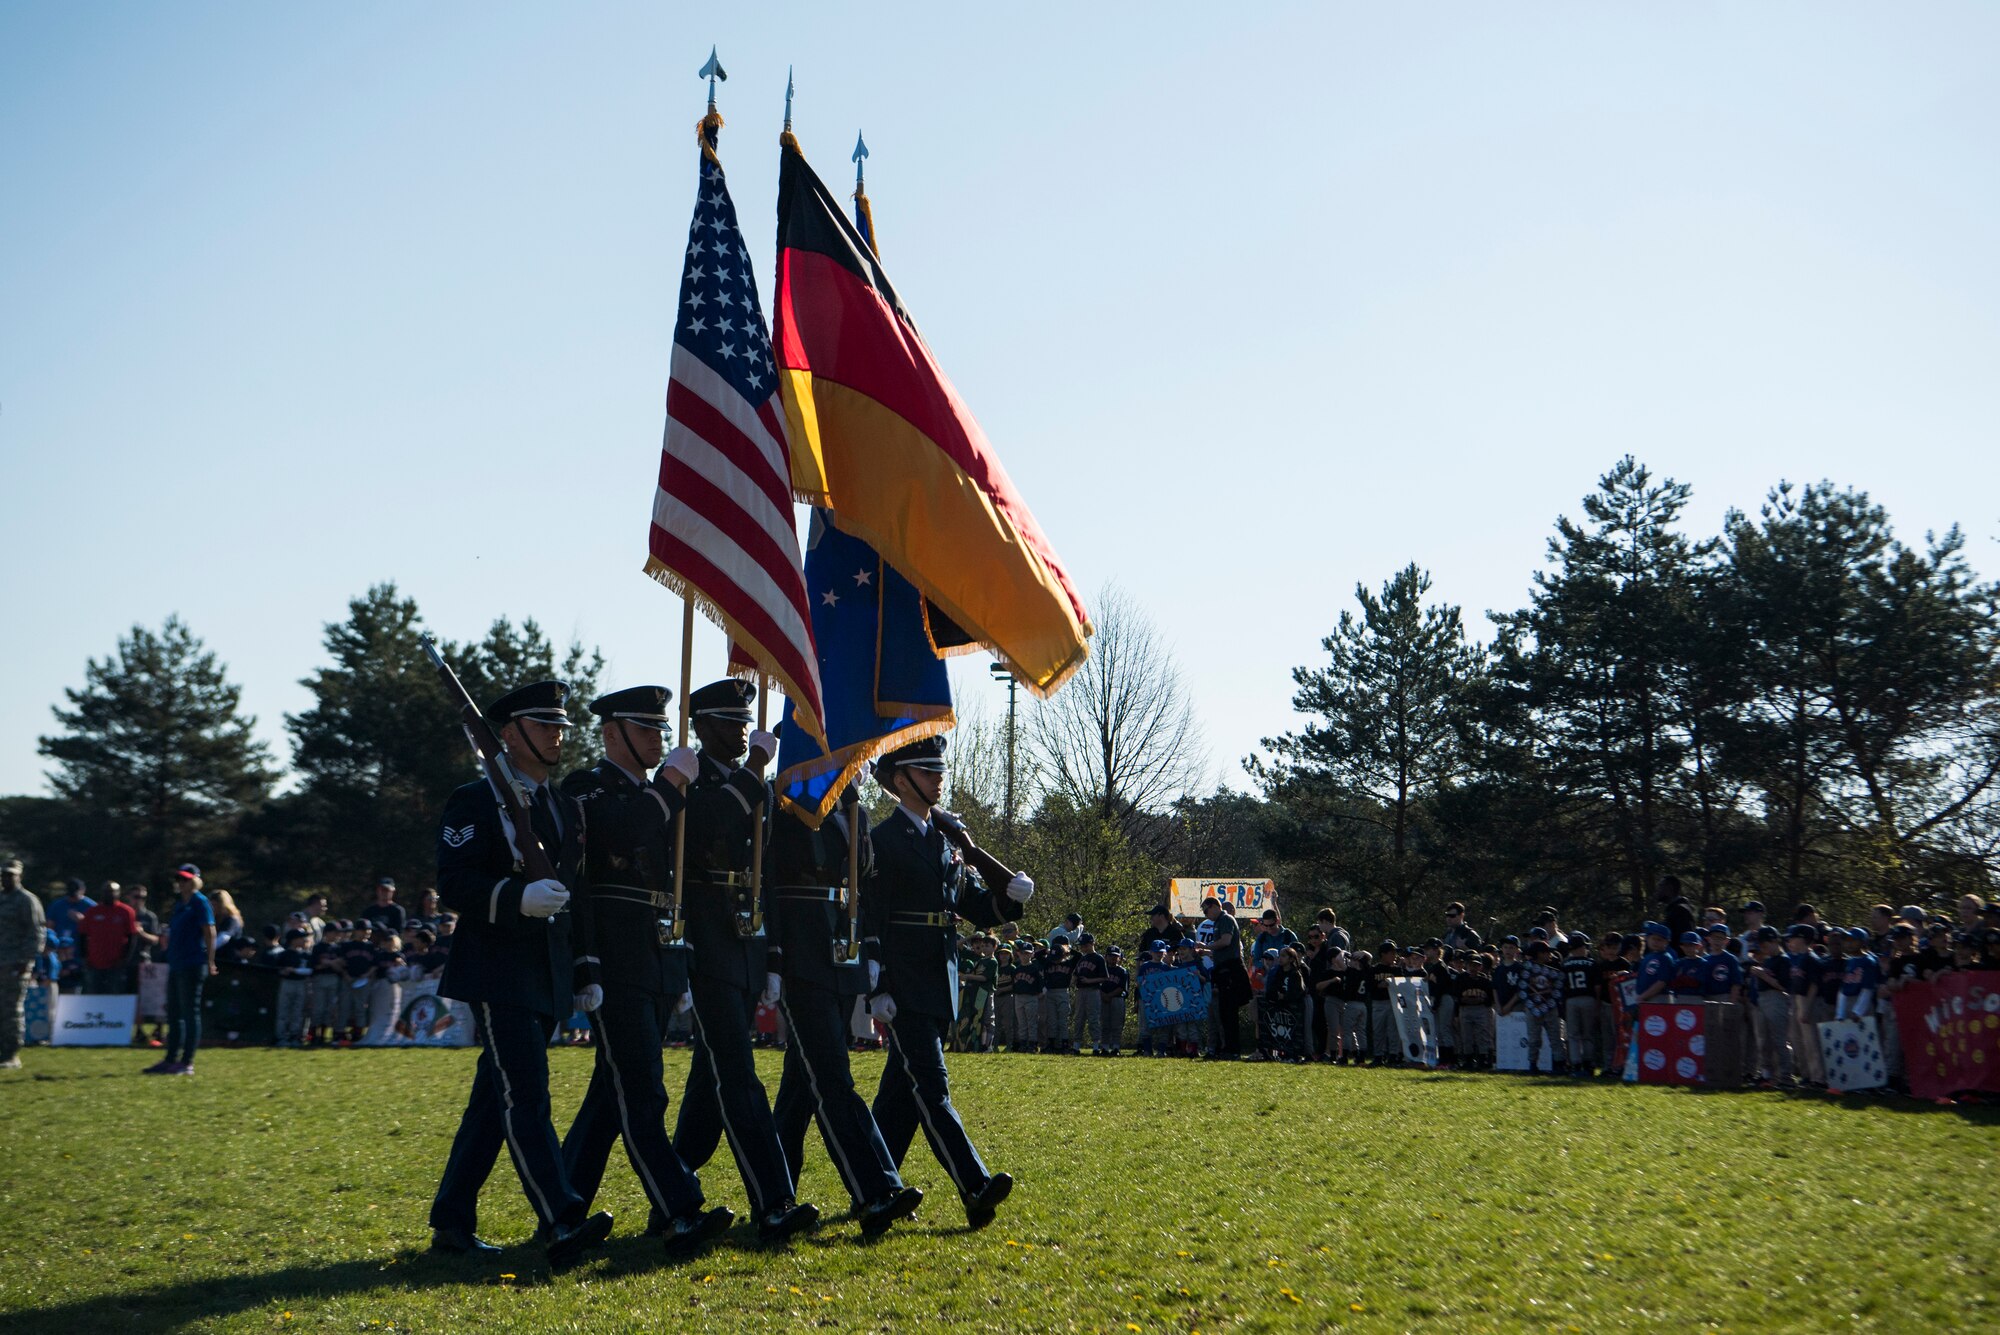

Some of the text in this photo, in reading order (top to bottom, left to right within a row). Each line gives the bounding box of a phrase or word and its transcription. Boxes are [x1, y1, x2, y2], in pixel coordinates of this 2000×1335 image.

[1206, 885, 1262, 907] ASTROS
[1357, 980, 1366, 994] 6
[1568, 971, 1587, 989] 12
[1270, 1023, 1292, 1040] SOX
